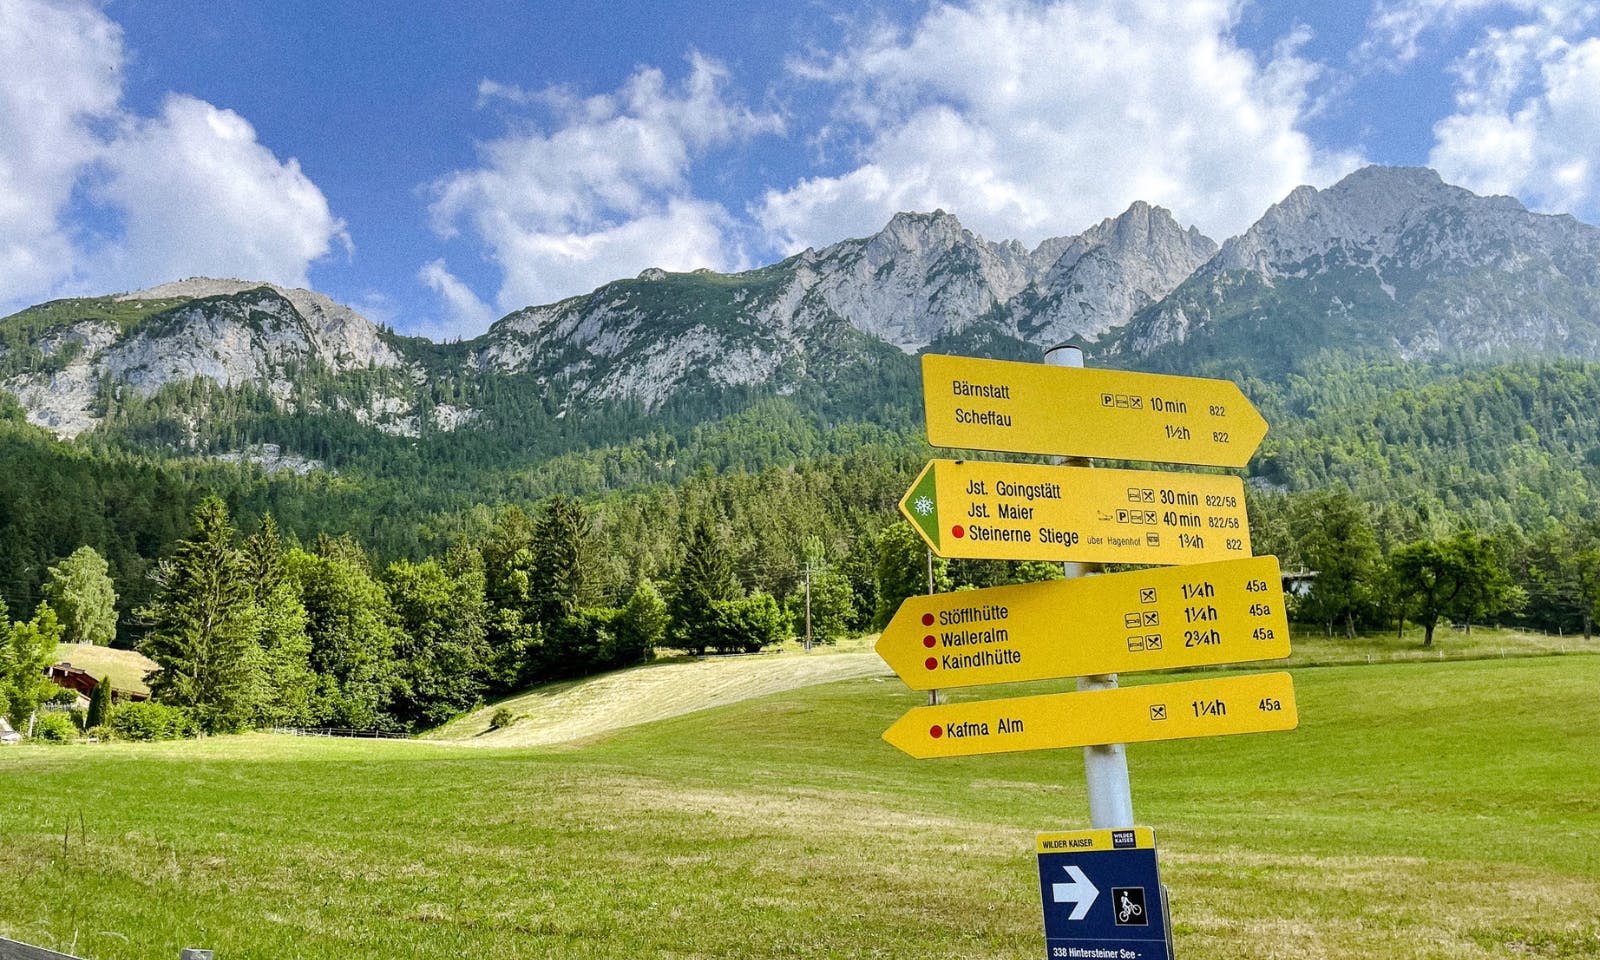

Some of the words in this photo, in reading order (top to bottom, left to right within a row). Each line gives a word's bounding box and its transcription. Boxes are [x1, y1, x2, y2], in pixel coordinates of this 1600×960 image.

[951, 380, 1010, 399] Bärnstatt
[1150, 397, 1163, 412] 10
[1165, 399, 1187, 414] min
[1209, 405, 1226, 417] 822
[955, 408, 1012, 427] Scheffau
[1213, 431, 1229, 443] 822
[966, 479, 989, 495] Jst.
[996, 481, 1061, 501] Goingstätt
[1160, 489, 1175, 505] 30
[1177, 490, 1199, 506] min
[1206, 495, 1237, 508] 822/58
[968, 502, 990, 518] Jst.
[998, 503, 1034, 520] Maier
[1163, 511, 1178, 527] 40
[1179, 513, 1201, 528] min
[1208, 516, 1240, 529] 822/58
[969, 524, 1031, 542] Steinerne
[1039, 527, 1079, 547] Stiege
[1087, 535, 1103, 545] über
[1107, 536, 1142, 547] Hagenhof
[1226, 538, 1243, 550] 822
[940, 605, 1008, 626] Stöfflhütte
[1246, 579, 1267, 593] 45a
[941, 628, 1008, 648] Walleralm
[1249, 603, 1271, 616] 45a
[942, 649, 1021, 670] Kaindlhütte
[1252, 628, 1274, 640] 45a
[947, 721, 989, 738] Kafma
[998, 718, 1024, 734] Alm
[1259, 698, 1281, 711] 45a
[1042, 839, 1068, 849] WILDER
[1069, 838, 1093, 848] KAISER
[1053, 947, 1067, 957] 338
[1069, 947, 1118, 958] Hintersteiner
[1120, 948, 1136, 959] See
